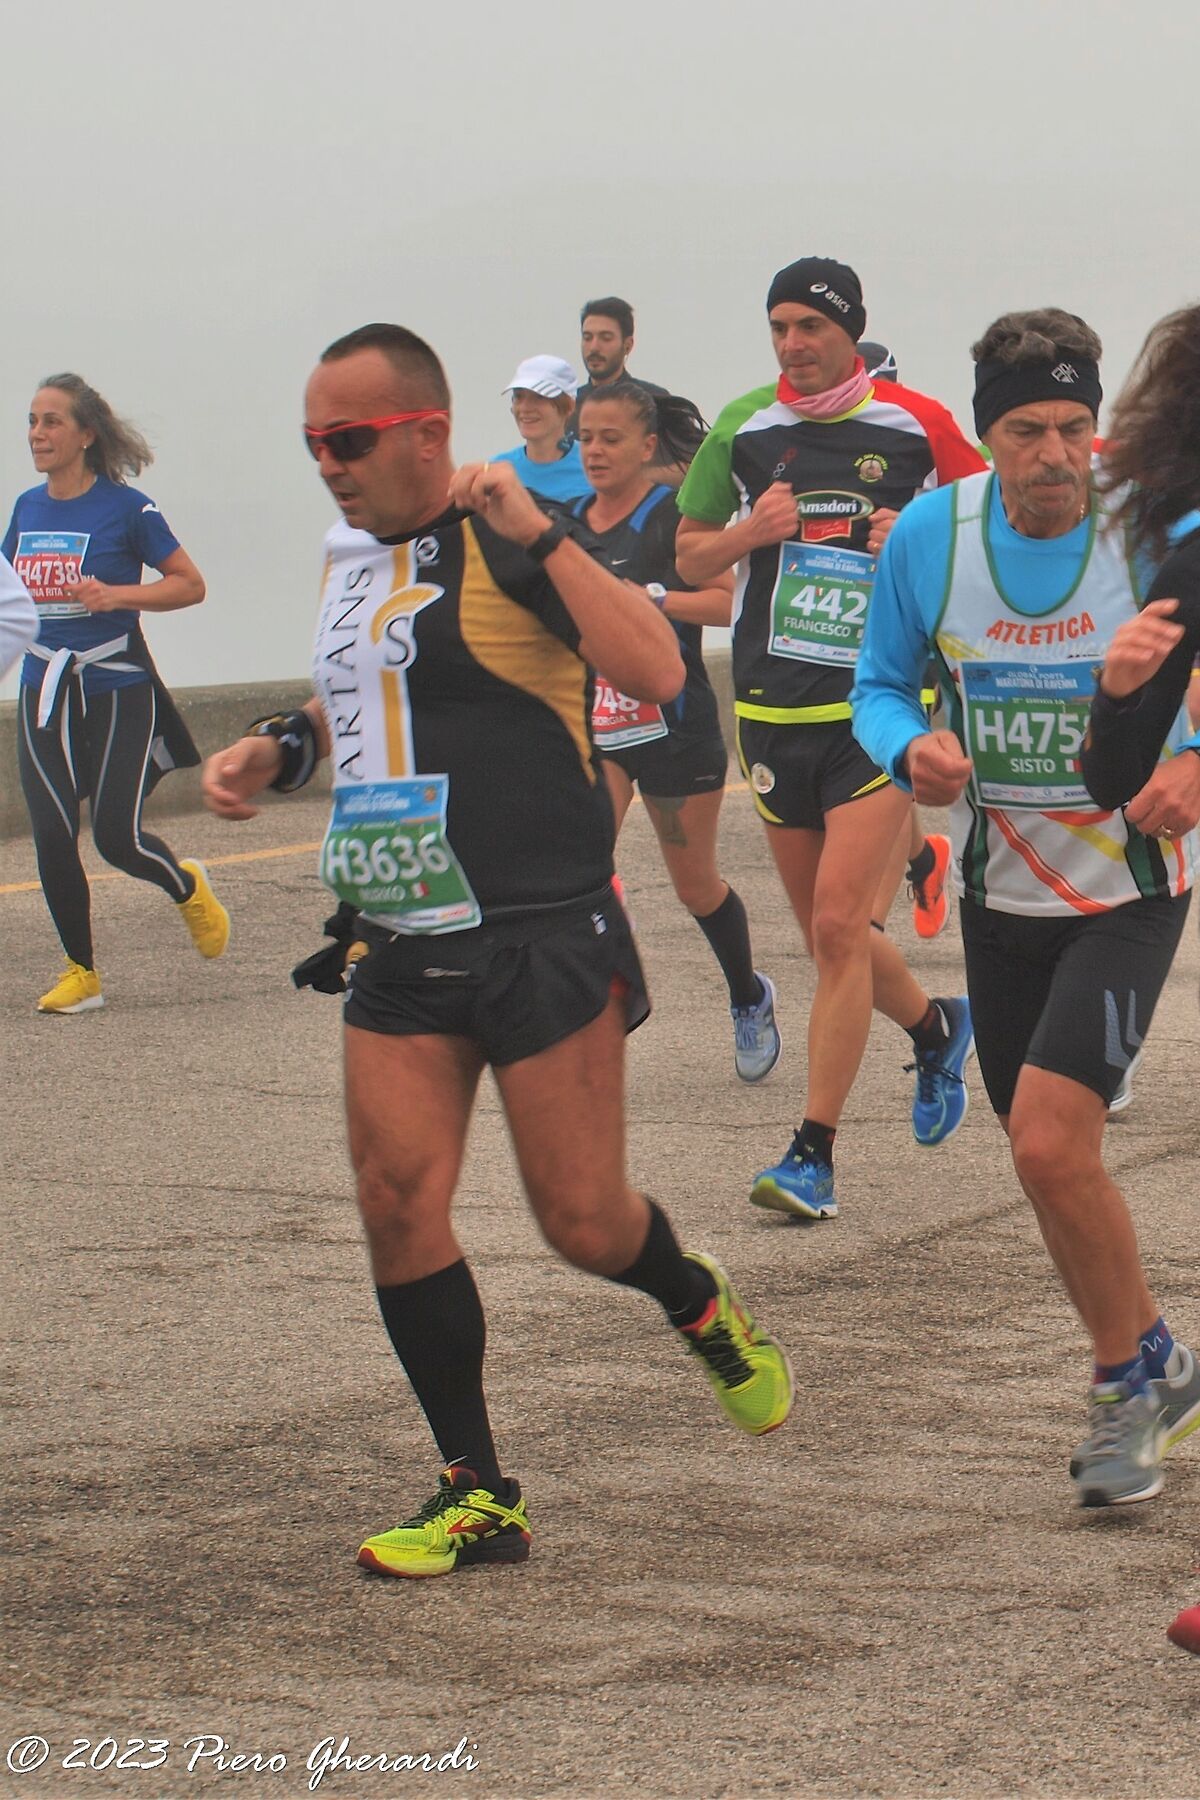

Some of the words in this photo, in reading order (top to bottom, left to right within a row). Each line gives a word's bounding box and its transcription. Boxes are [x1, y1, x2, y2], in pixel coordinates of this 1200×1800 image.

[824, 289, 851, 314] asics
[797, 499, 857, 514] Amadori
[17, 560, 80, 586] H4738
[45, 587, 63, 597] RITA
[789, 584, 868, 625] 442
[784, 616, 851, 638] FRANCESCO
[986, 612, 1096, 646] ATLETICA
[1010, 758, 1056, 774] SISTO
[325, 831, 451, 886] H3636
